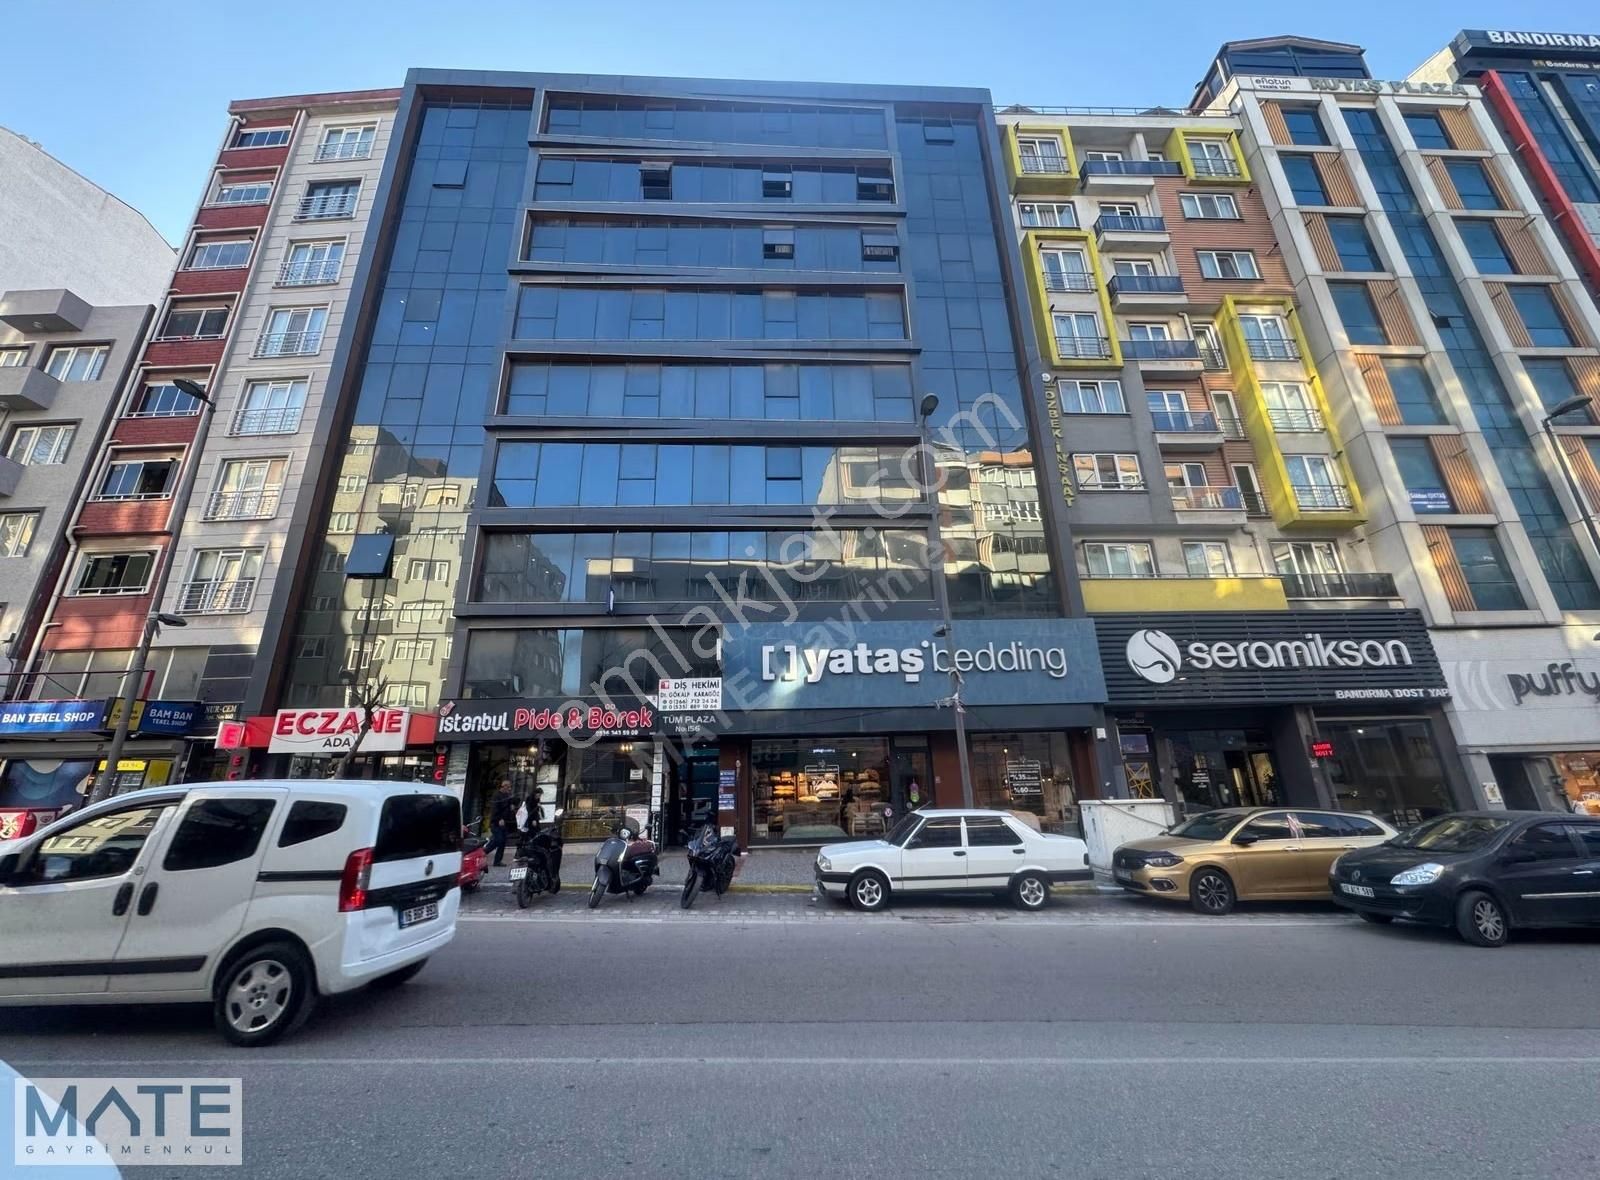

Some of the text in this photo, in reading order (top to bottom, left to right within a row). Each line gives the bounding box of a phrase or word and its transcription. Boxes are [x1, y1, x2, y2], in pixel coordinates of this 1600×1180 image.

[1487, 30, 1600, 47] BANDIRMA
[1390, 81, 1469, 96] PLAZA
[1188, 633, 1412, 669] seramiksan
[804, 642, 1067, 682] yataş bedding
[674, 680, 720, 690] DİŞ HEKİMİ
[1505, 662, 1600, 706] puffy
[1335, 688, 1392, 700] BANDIRMA
[1394, 688, 1424, 698] DOST
[28, 713, 61, 723] TEKEL
[64, 712, 95, 722] SHOP
[150, 708, 172, 719] BAM
[173, 710, 193, 721] BAN
[514, 708, 563, 730] Pide
[568, 708, 583, 729] &
[588, 704, 653, 729] Börek
[662, 714, 716, 724] TÜM PLAZA
[171, 719, 187, 727] SHOP
[276, 710, 404, 735] ECZANE
[323, 737, 351, 748] ADA
